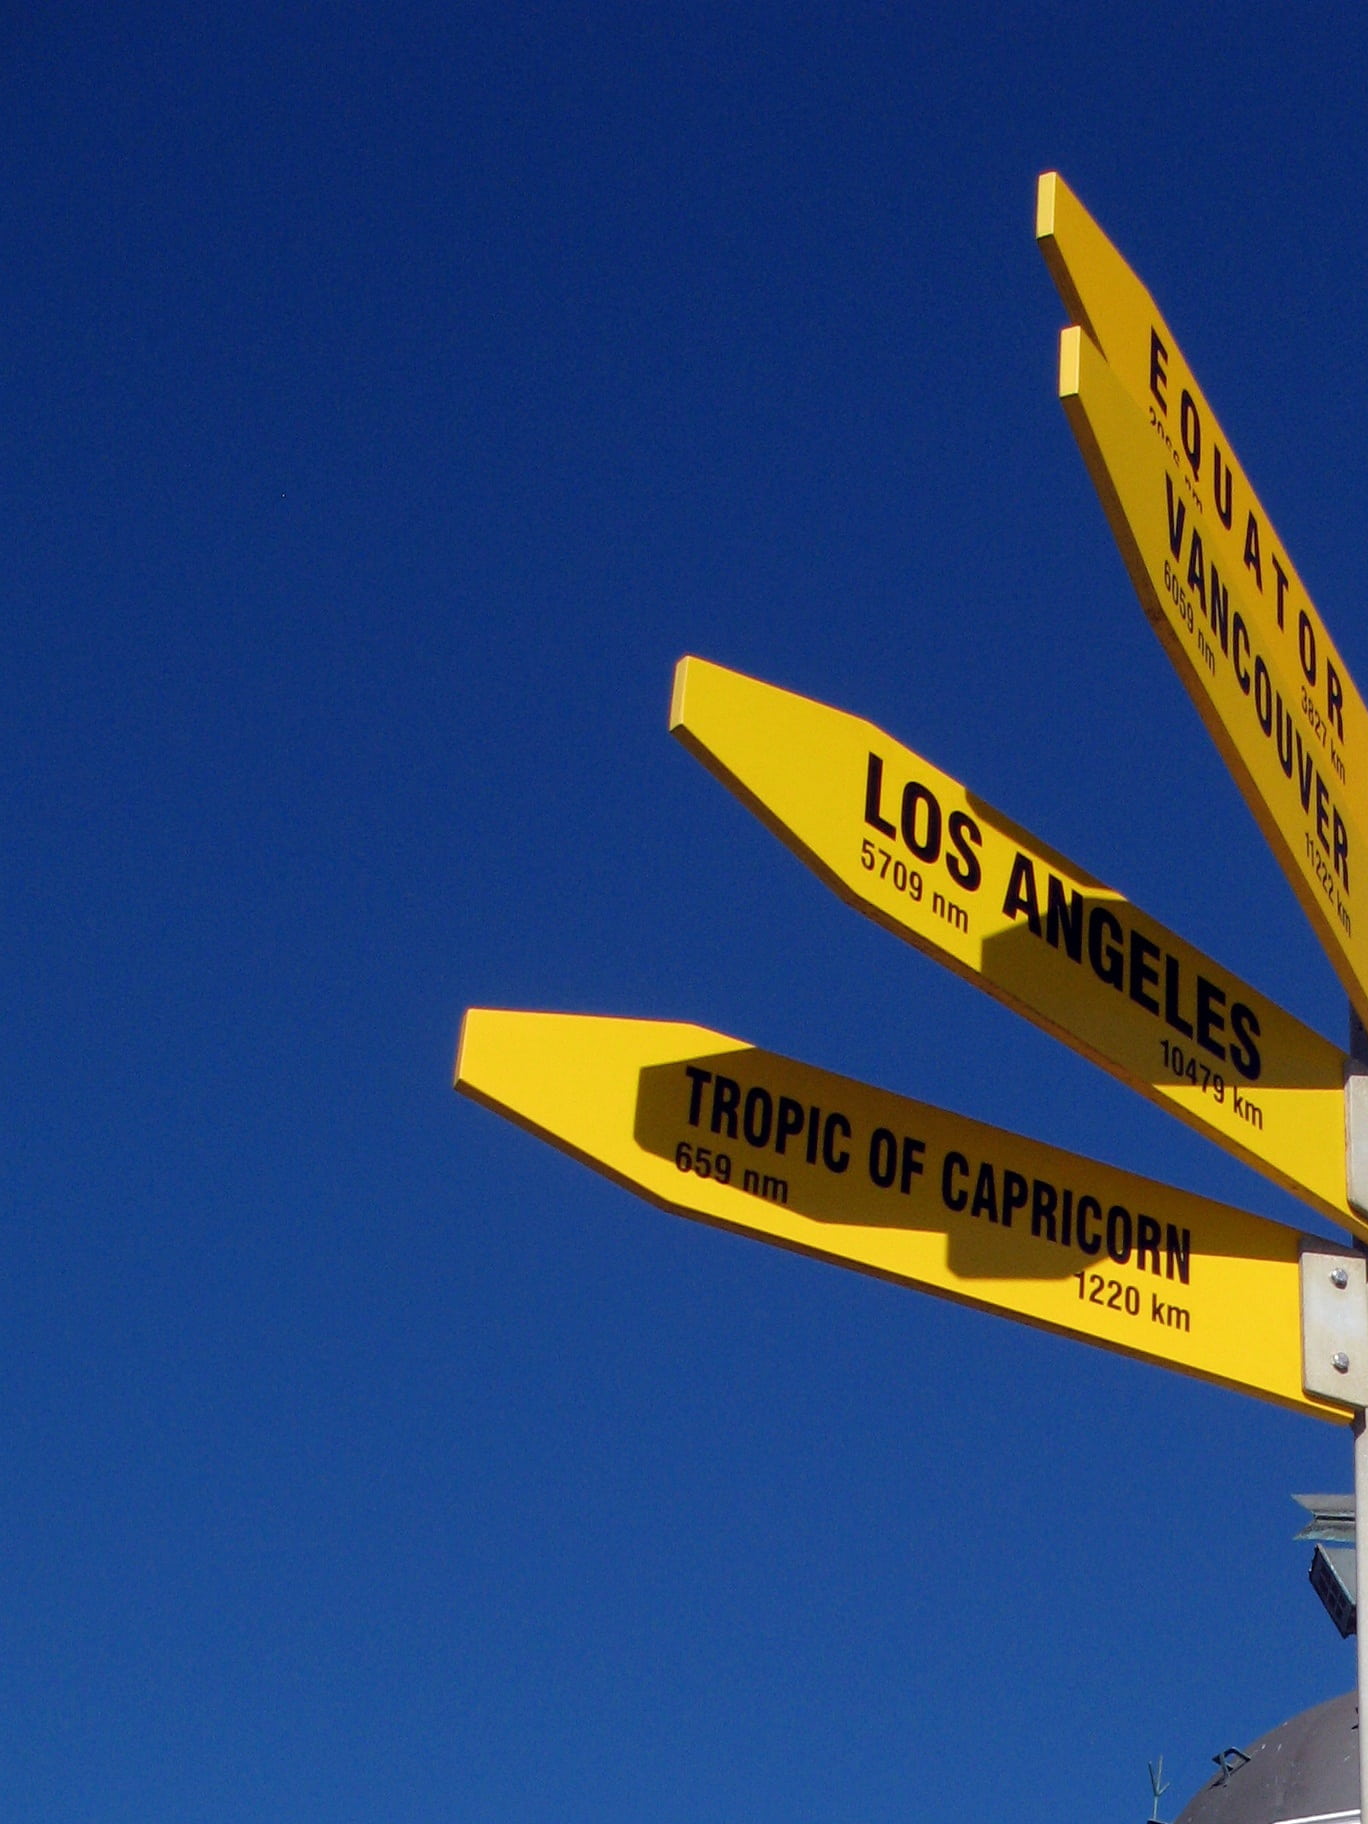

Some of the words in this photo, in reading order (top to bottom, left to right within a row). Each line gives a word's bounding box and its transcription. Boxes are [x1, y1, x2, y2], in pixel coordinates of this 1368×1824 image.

[1150, 325, 1344, 744] EQUATOR
[1163, 560, 1193, 634] 6059
[1198, 628, 1215, 677] nm
[1165, 469, 1349, 896] VANCOUVER
[1301, 685, 1327, 748] 3827
[1330, 738, 1345, 785] km
[861, 841, 923, 902] 5709
[932, 890, 968, 933] nm
[865, 752, 982, 892] LOS
[1003, 852, 1262, 1081] ANGELES
[1305, 832, 1335, 905] 11222
[1336, 890, 1351, 938] km
[1160, 1040, 1225, 1108] 10479
[1233, 1085, 1263, 1130] km
[675, 1142, 732, 1184] 659
[743, 1168, 788, 1205] nm
[685, 1066, 852, 1173] TROPIC
[870, 1128, 926, 1195] OF
[942, 1151, 1191, 1285] CAPRICORN
[1074, 1271, 1140, 1317] 1220
[1151, 1290, 1191, 1332] km
